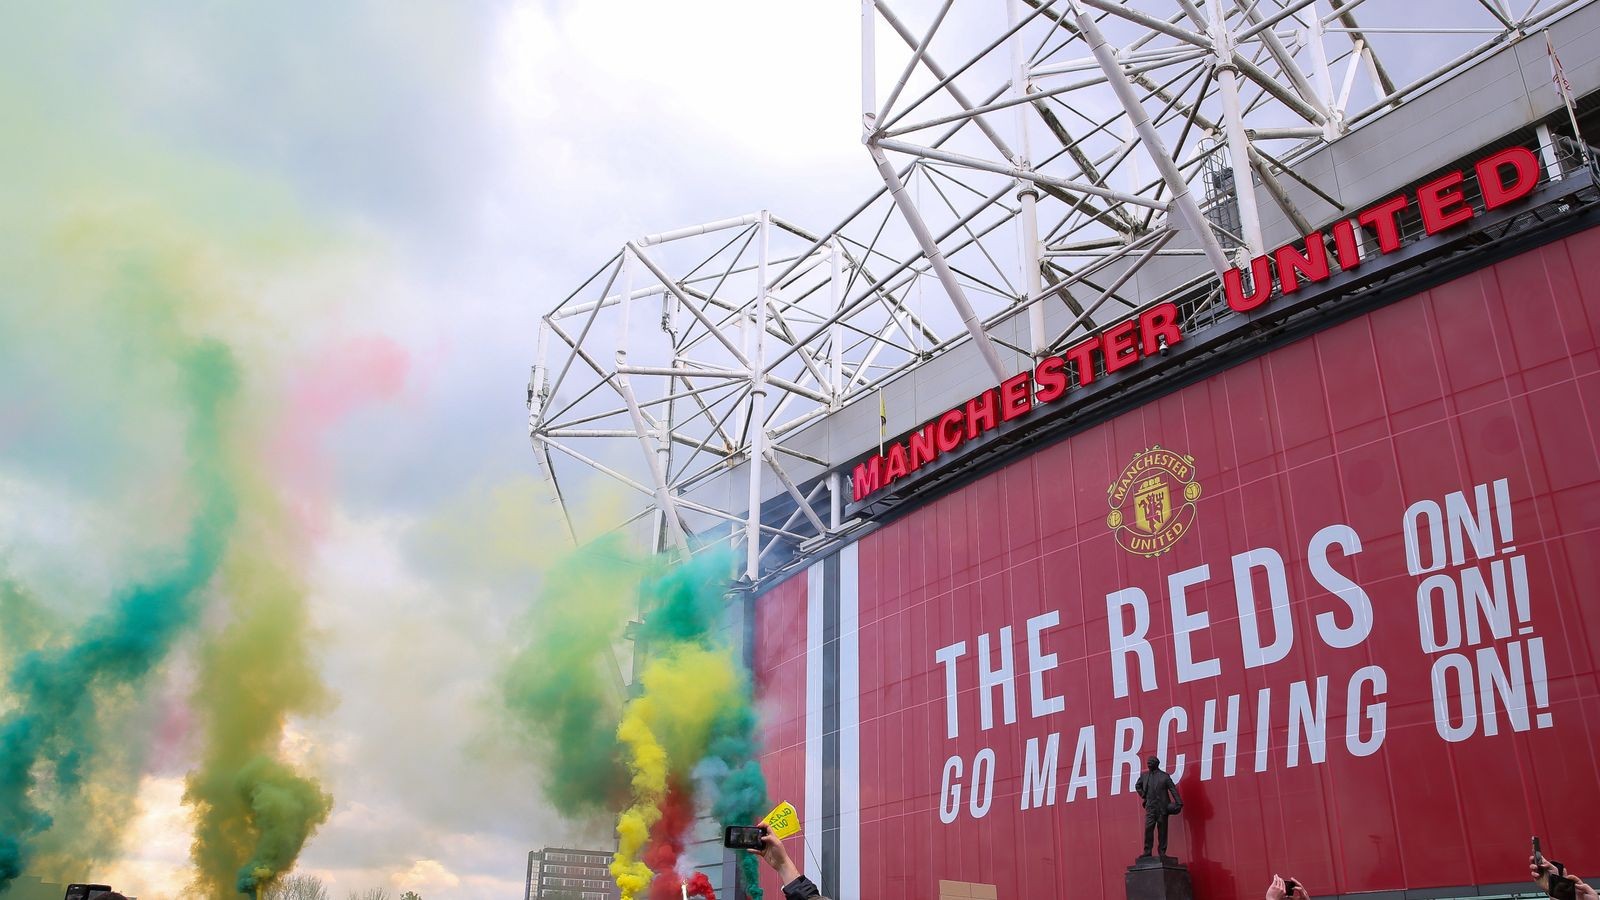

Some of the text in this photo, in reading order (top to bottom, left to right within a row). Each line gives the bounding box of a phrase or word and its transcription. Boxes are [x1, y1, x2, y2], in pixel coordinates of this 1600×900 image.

[853, 145, 1540, 502] MANCHESTER UNITED
[1114, 453, 1188, 500] MANCHESTER
[1402, 478, 1517, 577] ON!
[1130, 522, 1183, 550] UNITED
[935, 523, 1374, 740] THE REDS
[1416, 554, 1534, 655] ON!
[1430, 636, 1554, 743] ON!
[939, 664, 1388, 825] GO MARCHING
